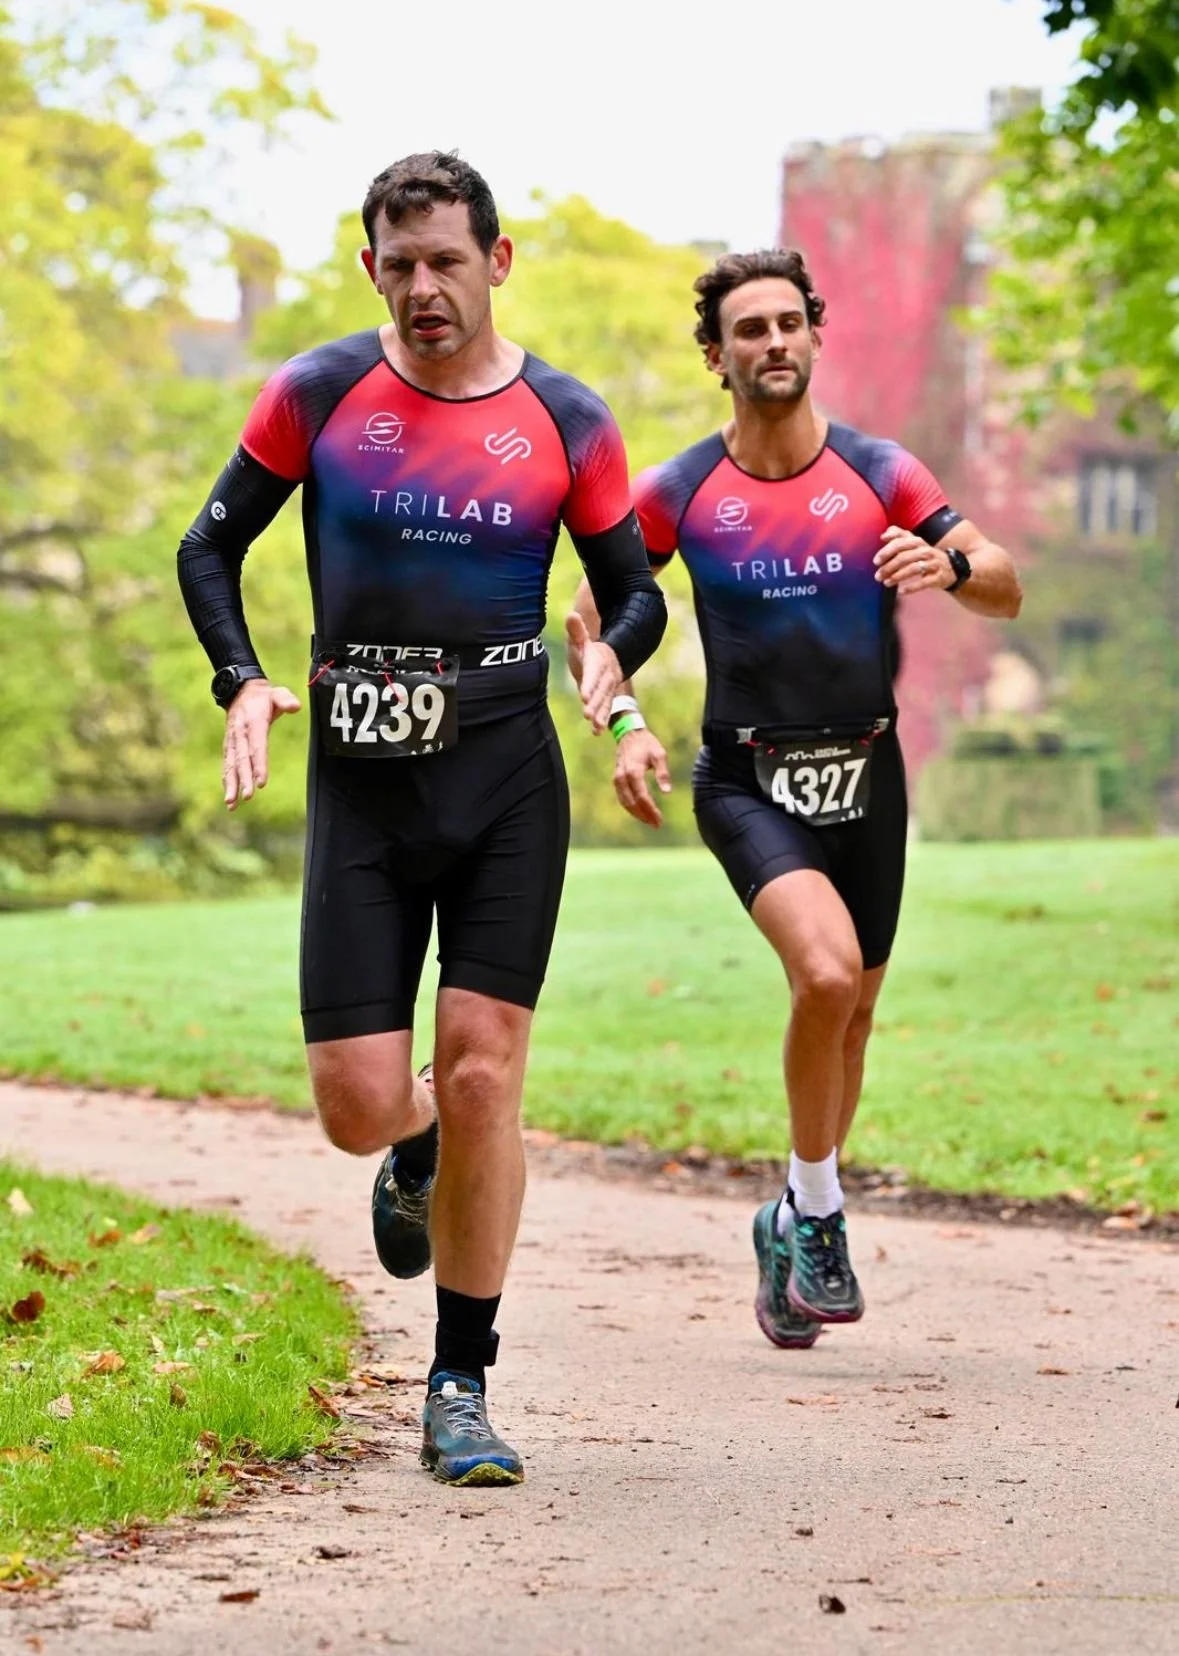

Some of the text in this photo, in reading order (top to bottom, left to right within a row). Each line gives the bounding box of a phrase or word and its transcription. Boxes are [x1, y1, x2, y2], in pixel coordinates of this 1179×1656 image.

[358, 444, 404, 454] SCIMITAR
[371, 489, 513, 526] TRILAB
[401, 528, 473, 545] RACING
[732, 552, 843, 581] TRILAB
[762, 584, 818, 599] RACING
[330, 682, 446, 743] 4239
[771, 757, 867, 816] 4327
